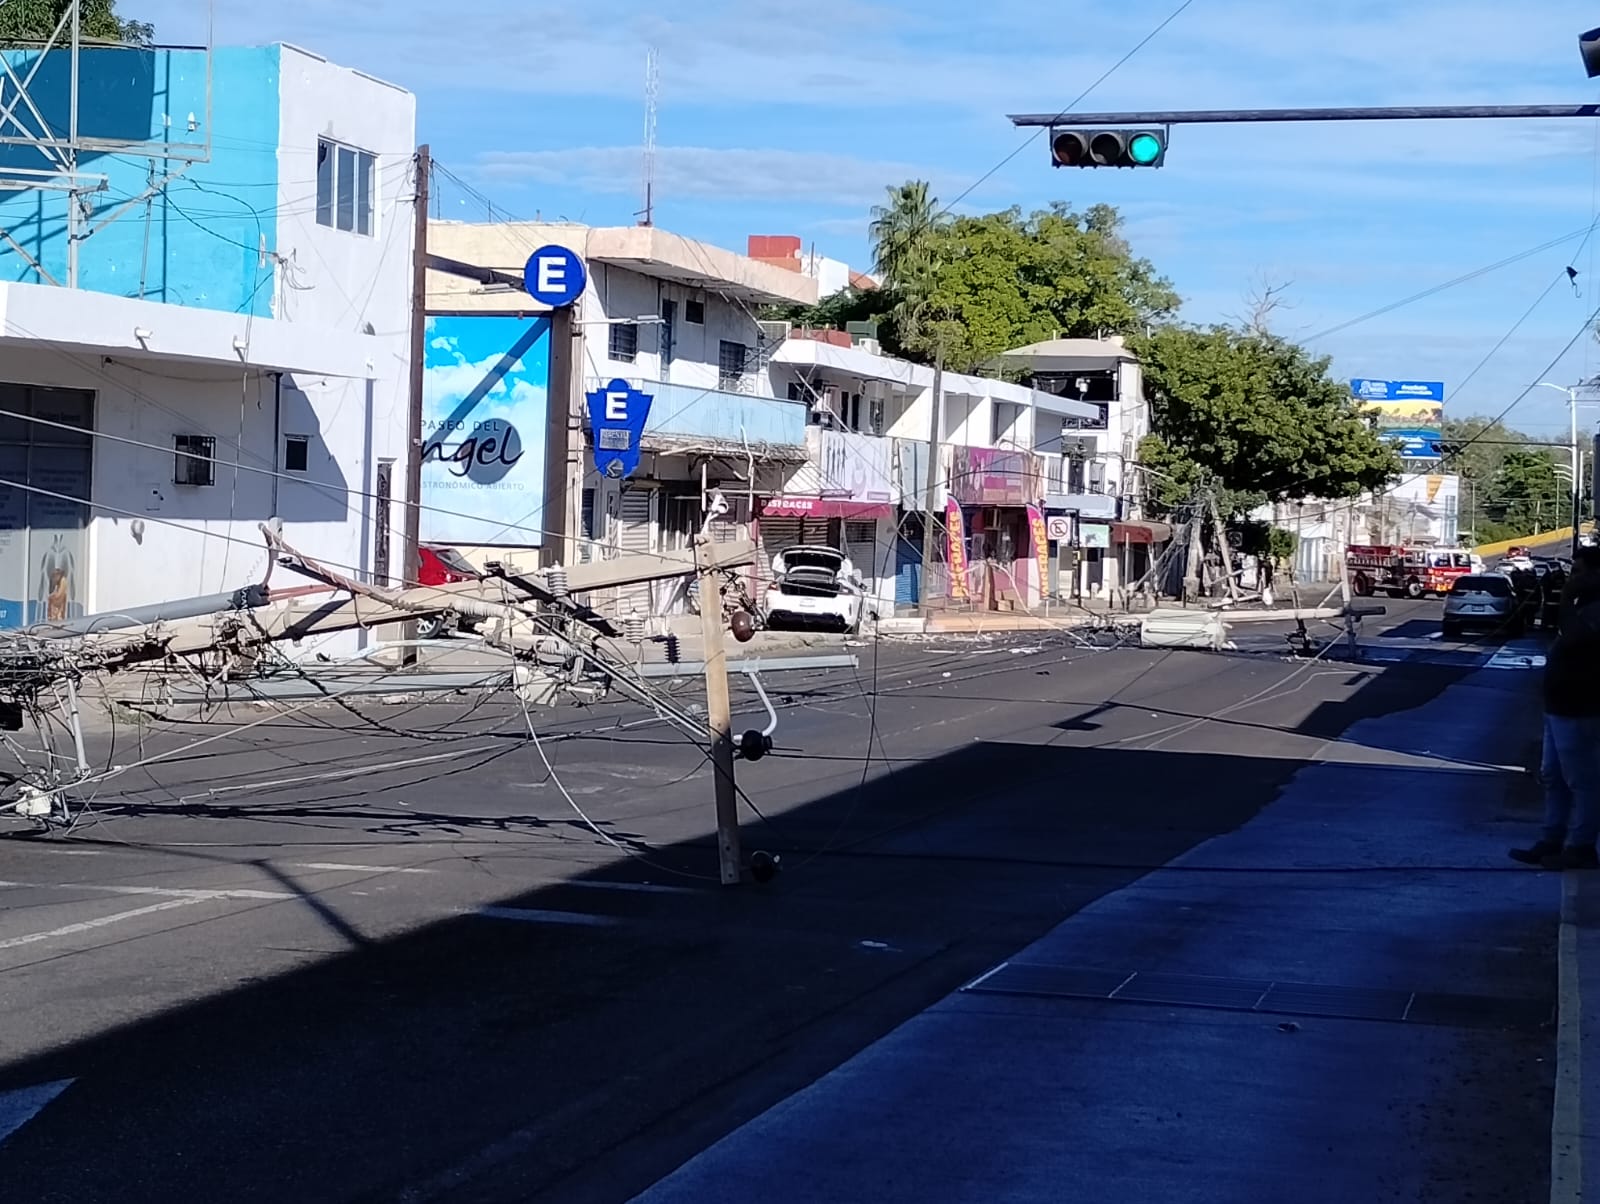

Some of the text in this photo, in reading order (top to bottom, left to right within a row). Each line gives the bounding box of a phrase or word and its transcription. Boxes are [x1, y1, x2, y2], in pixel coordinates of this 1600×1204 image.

[538, 257, 567, 293] E
[606, 392, 628, 420] E
[420, 419, 500, 432] PASEO DEL
[421, 426, 525, 477] ngel
[486, 483, 525, 491] ABIERTO
